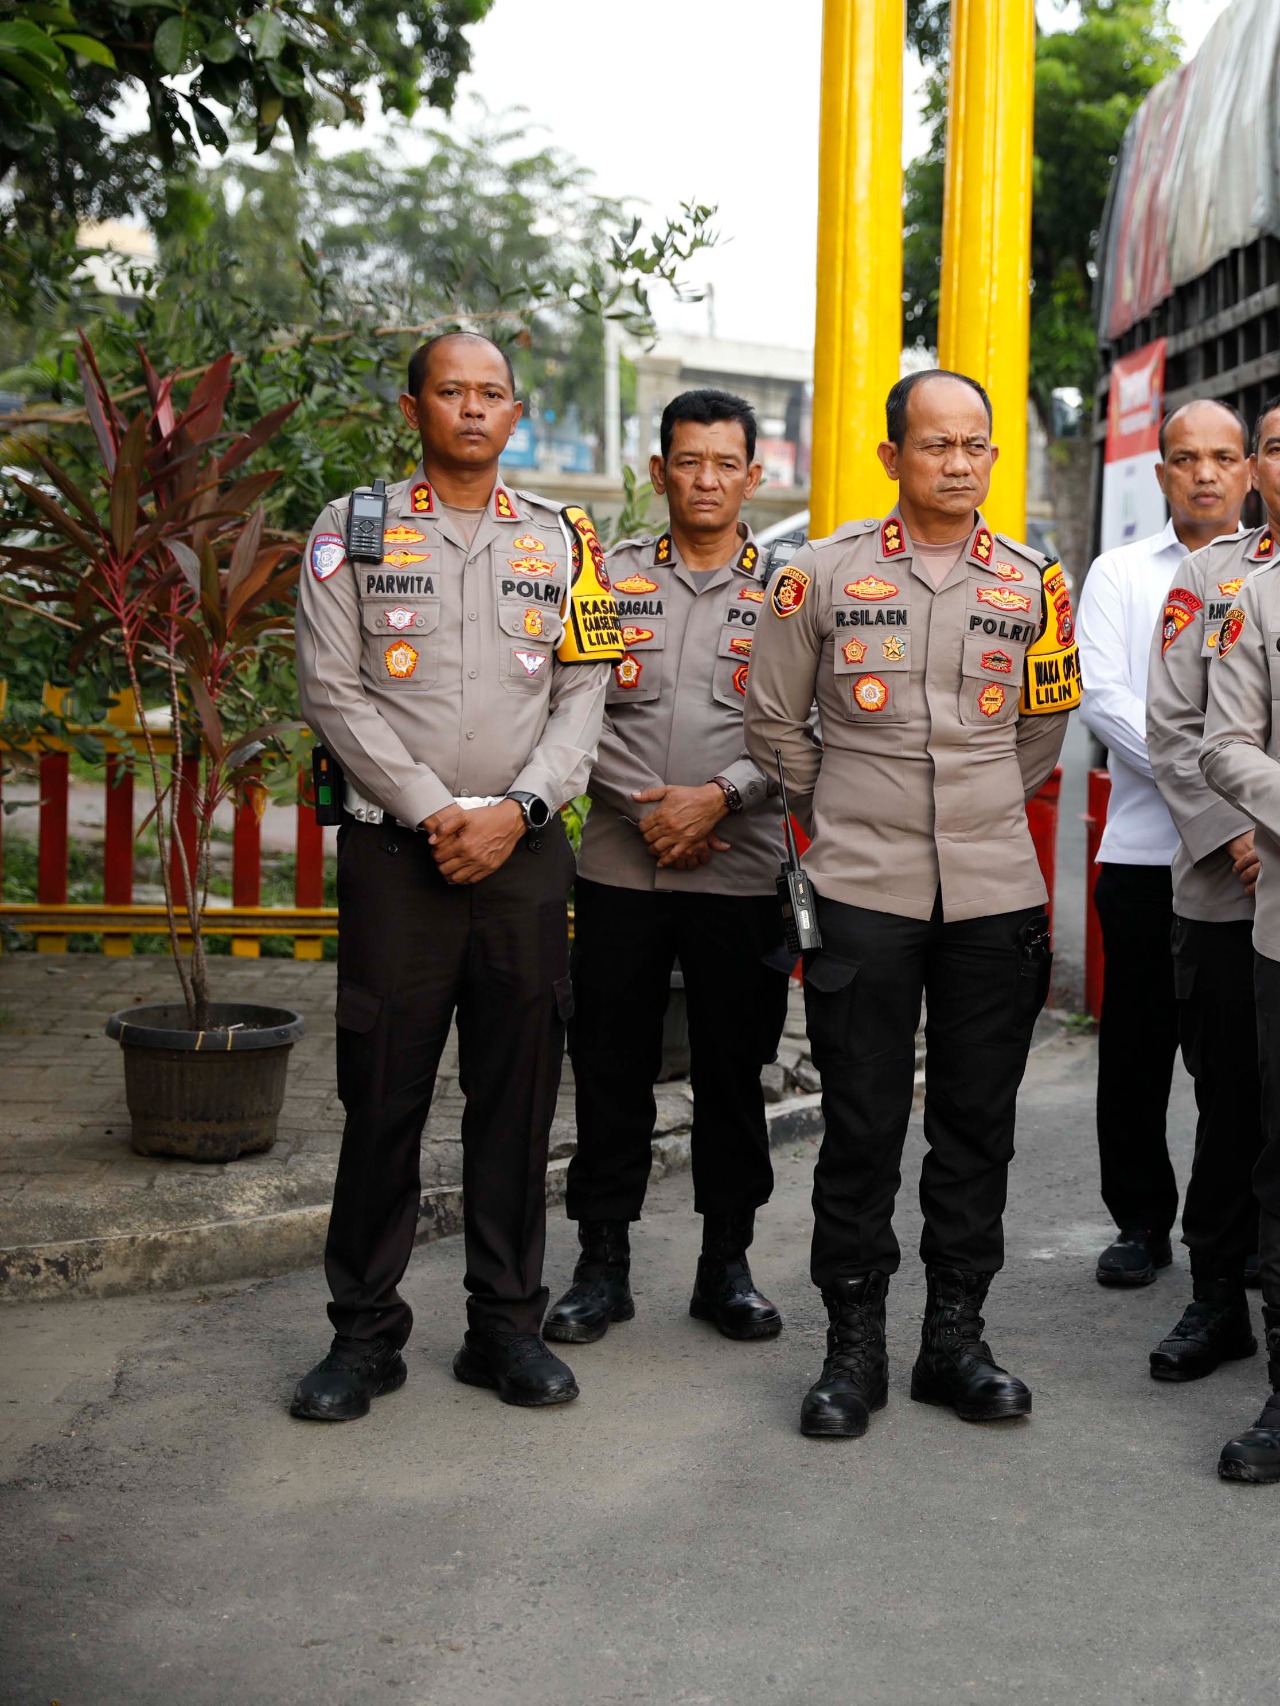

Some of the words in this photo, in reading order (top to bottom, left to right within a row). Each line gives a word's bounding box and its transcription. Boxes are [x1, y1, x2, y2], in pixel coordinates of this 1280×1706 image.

[366, 574, 434, 594] PARWITA
[501, 579, 561, 605] POLRI
[836, 609, 908, 628] R.SILAEN
[969, 615, 1031, 642] POLRI
[587, 630, 619, 646] LILIN
[1034, 658, 1060, 687] WAKA
[1035, 682, 1072, 705] LILIN
